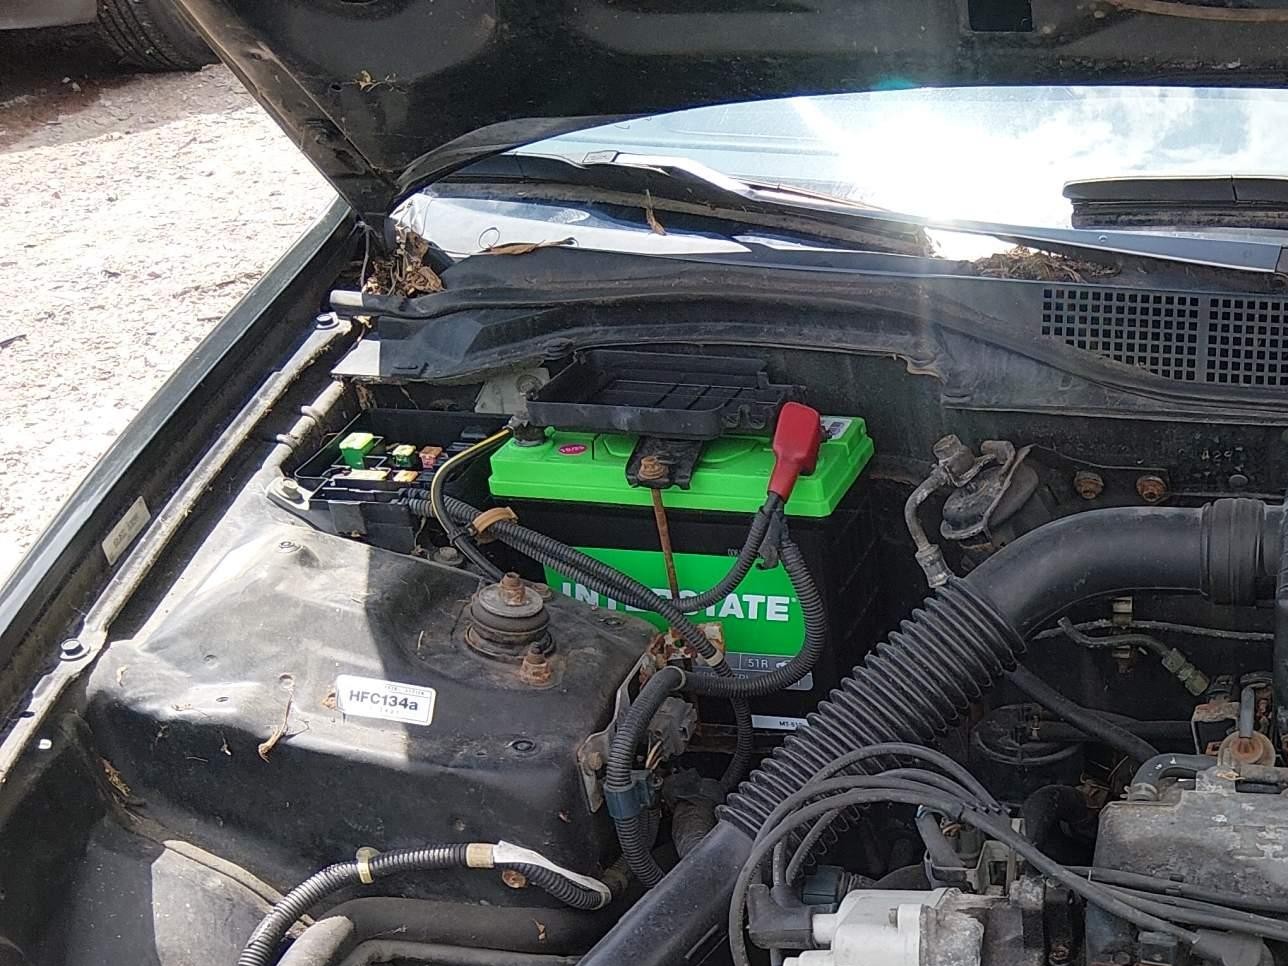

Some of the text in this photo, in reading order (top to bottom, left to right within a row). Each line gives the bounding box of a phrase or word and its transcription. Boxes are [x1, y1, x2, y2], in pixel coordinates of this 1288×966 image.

[562, 583, 789, 621] INATE
[748, 659, 768, 668] 51R
[349, 690, 418, 711] HFC134a
